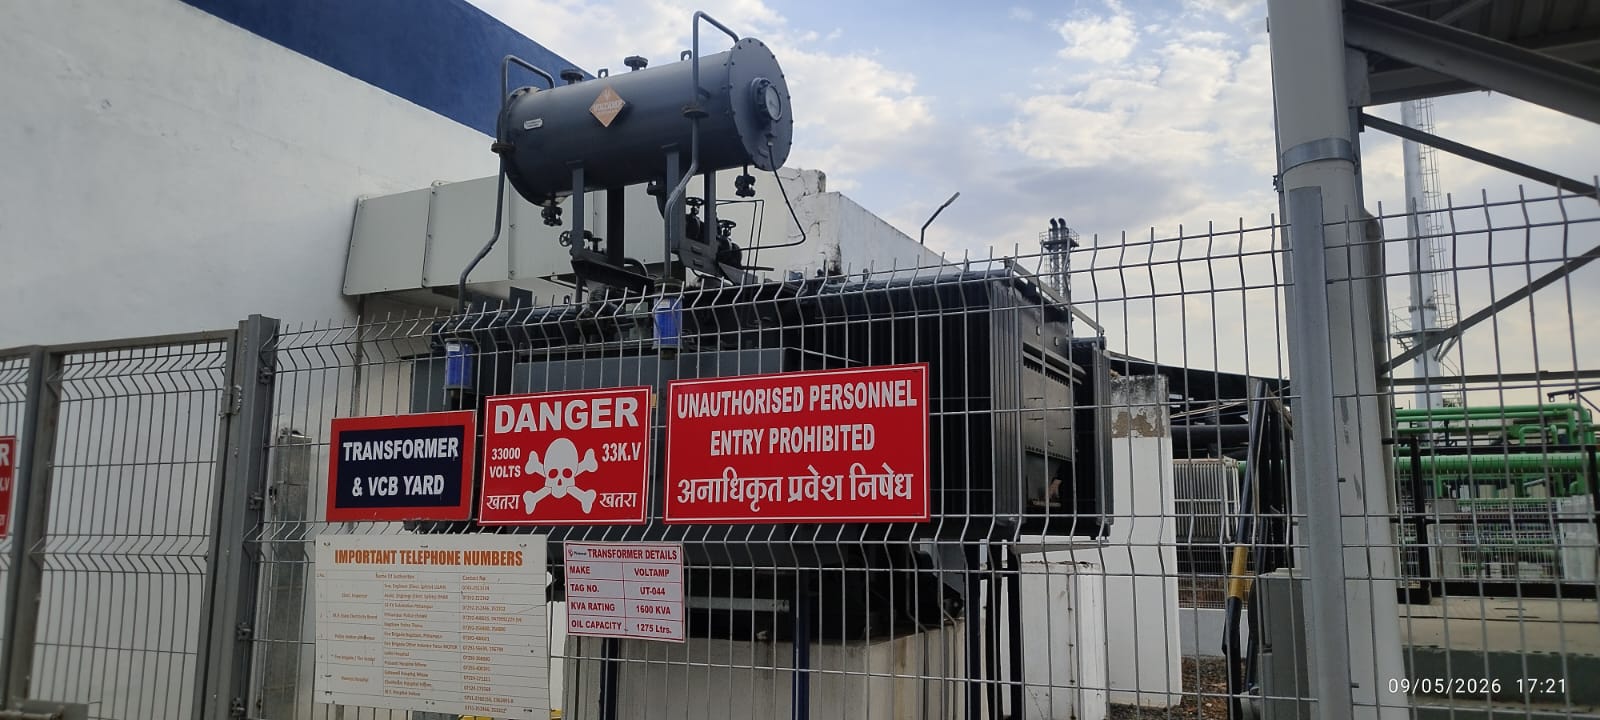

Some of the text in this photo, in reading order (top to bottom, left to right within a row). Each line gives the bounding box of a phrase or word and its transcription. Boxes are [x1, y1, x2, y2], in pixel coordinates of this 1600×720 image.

[677, 380, 917, 418] UNAUTHORISED PERSONNEL
[494, 397, 639, 434] DANGER
[710, 424, 875, 456] ENTRY PROHIBITED
[343, 437, 459, 461] TRANSFORMER
[491, 447, 521, 460] 33000
[602, 442, 642, 462] 33K.V
[490, 465, 521, 478] VOLTS
[352, 475, 444, 496] & VCB YARD
[677, 462, 913, 512] अनाधिकृत प्रवेश निषेध
[486, 494, 520, 510] खतरा
[599, 492, 637, 508] खतरा
[335, 550, 523, 566] IMPORTANT TELEPHONE NUMBERS
[587, 549, 642, 559] TRANSFORMER
[646, 550, 677, 560] DETAILS
[569, 566, 590, 574] MAKE
[634, 568, 670, 577] VOLTAMP
[570, 584, 584, 592] TAG
[640, 587, 665, 595] UT-044
[571, 602, 615, 611] KVA RATING
[636, 605, 671, 614] 1600 KVA
[572, 620, 622, 630] OIL CAPACITY
[637, 624, 672, 634] 1275 Ltrs.
